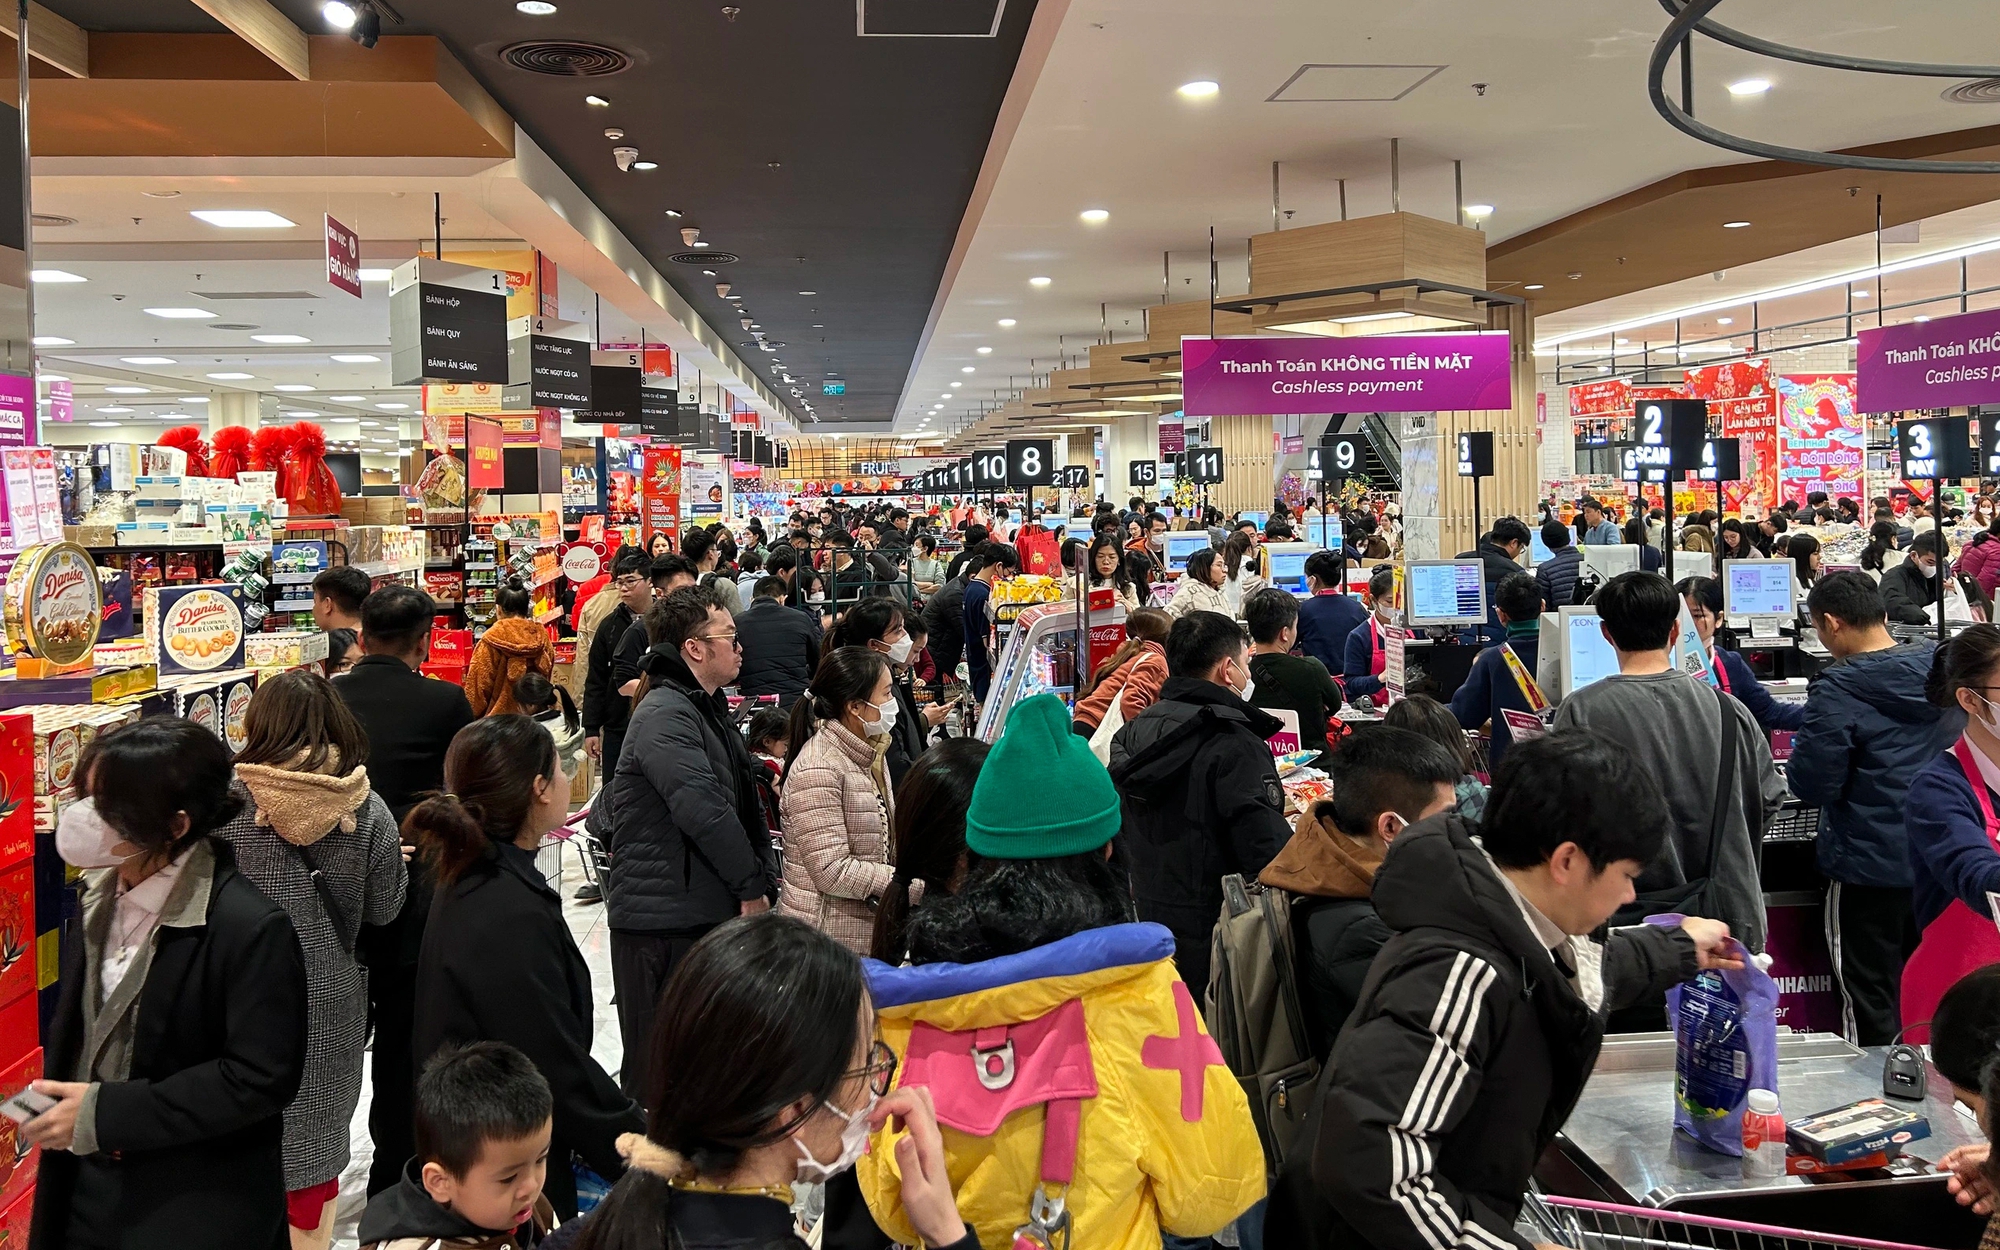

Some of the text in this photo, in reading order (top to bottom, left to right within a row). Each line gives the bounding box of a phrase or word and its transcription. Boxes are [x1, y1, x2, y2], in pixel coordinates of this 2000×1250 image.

[492, 274, 500, 290] 1
[426, 295, 460, 308] BÁNH HỘP
[426, 327, 461, 339] BÁNH QUY
[524, 320, 529, 332] 3
[536, 320, 544, 332] 4
[1885, 331, 2000, 365] Thanh Toán KHÔ
[427, 358, 478, 371] BÁNH ĂN SÁNG
[629, 355, 637, 365] 5
[1220, 351, 1473, 374] Thanh Toán KHÔNG TIỀN MẶT
[535, 366, 549, 375] NƯỚC
[550, 369, 563, 377] NGỌT
[1925, 365, 1988, 385] Cashless
[535, 390, 549, 399] NƯỚC
[550, 392, 563, 400] NGỌT
[564, 393, 580, 402] KHÔNG
[1271, 378, 1424, 396] Cashless payment
[689, 394, 695, 402] 9
[1643, 405, 1663, 444] 2
[1460, 436, 1470, 461] 3
[1908, 423, 1932, 458] 3
[1021, 446, 1042, 477] 8
[1310, 449, 1320, 469] 4
[1336, 440, 1355, 470] 9
[1624, 449, 1636, 469] 6
[1635, 446, 1670, 465] SCAN
[1702, 441, 1716, 465] 4
[978, 455, 1006, 479] 10
[1134, 464, 1154, 481] 15
[1196, 452, 1218, 477] 11
[1906, 459, 1936, 477] PAY
[1066, 468, 1084, 484] 17
[42, 566, 86, 600] Danisa
[175, 601, 227, 627] Danisa
[178, 624, 230, 634] BUTTER COOKIES
